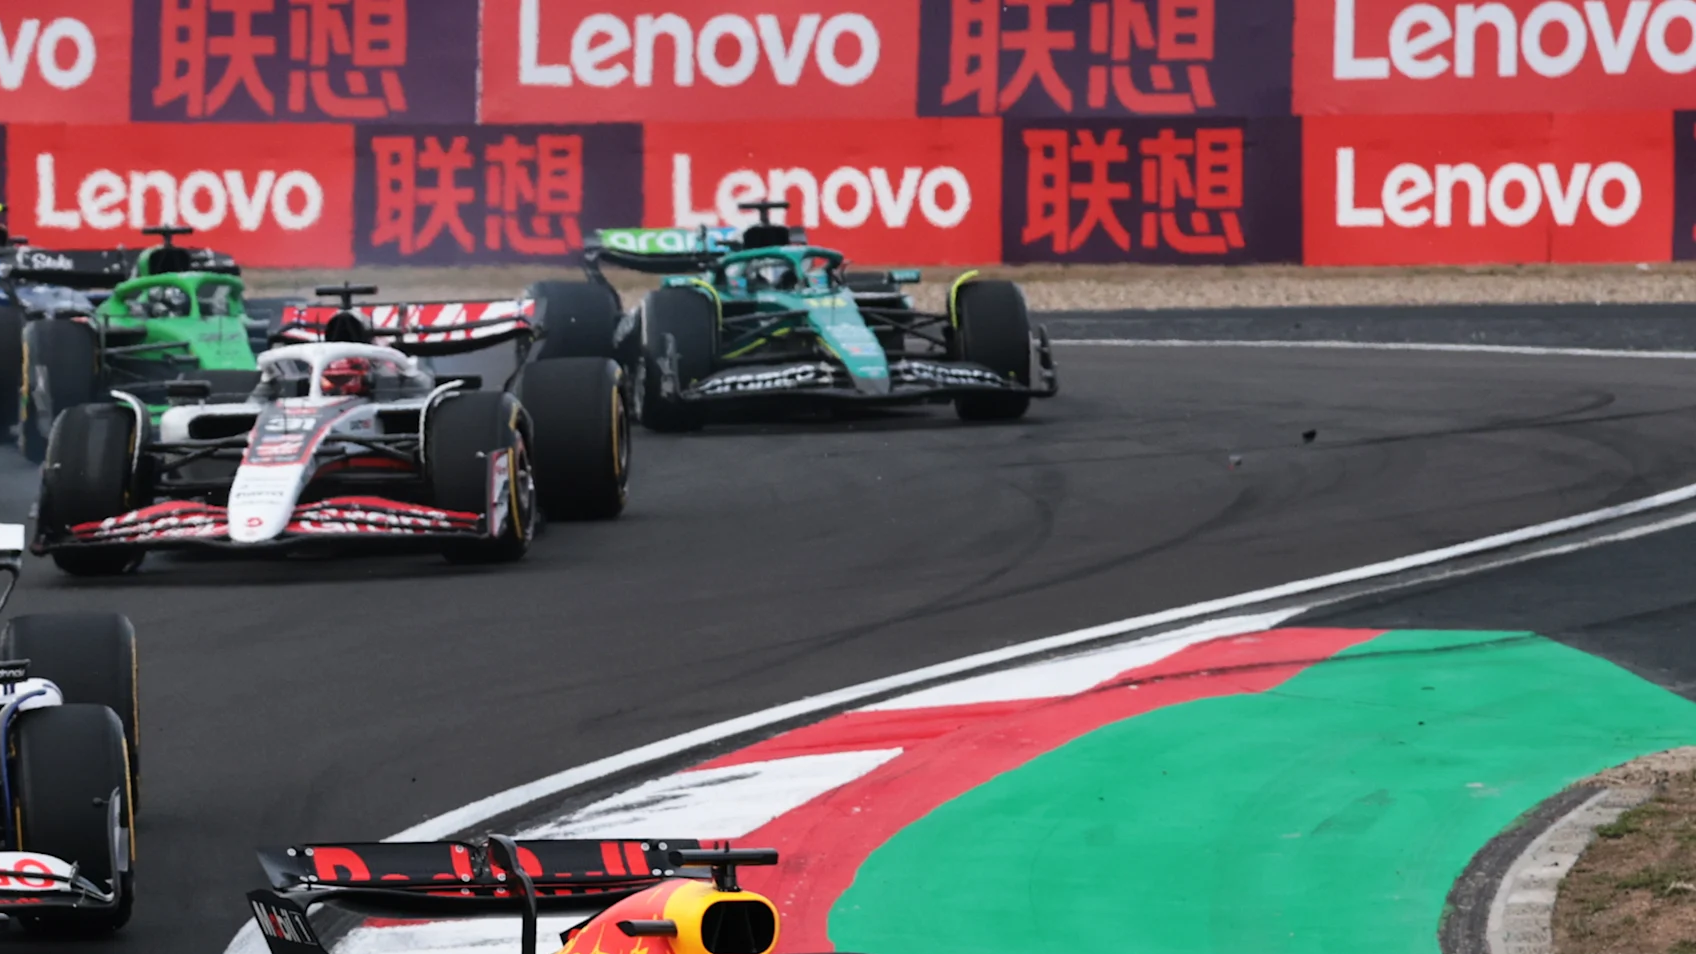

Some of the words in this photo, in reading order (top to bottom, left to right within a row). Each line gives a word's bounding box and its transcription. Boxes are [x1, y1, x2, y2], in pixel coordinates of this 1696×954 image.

[152, 0, 408, 120] 联想
[518, 0, 880, 87] Lenovo
[941, 0, 1217, 114] 联想
[1333, 0, 1696, 79] Lenovo
[36, 153, 323, 230] Lenovo
[371, 134, 584, 254] 联想
[672, 153, 972, 229] Lenovo
[1021, 128, 1245, 254] 联想
[1335, 147, 1642, 227] Lenovo
[252, 899, 302, 944] Mobil
